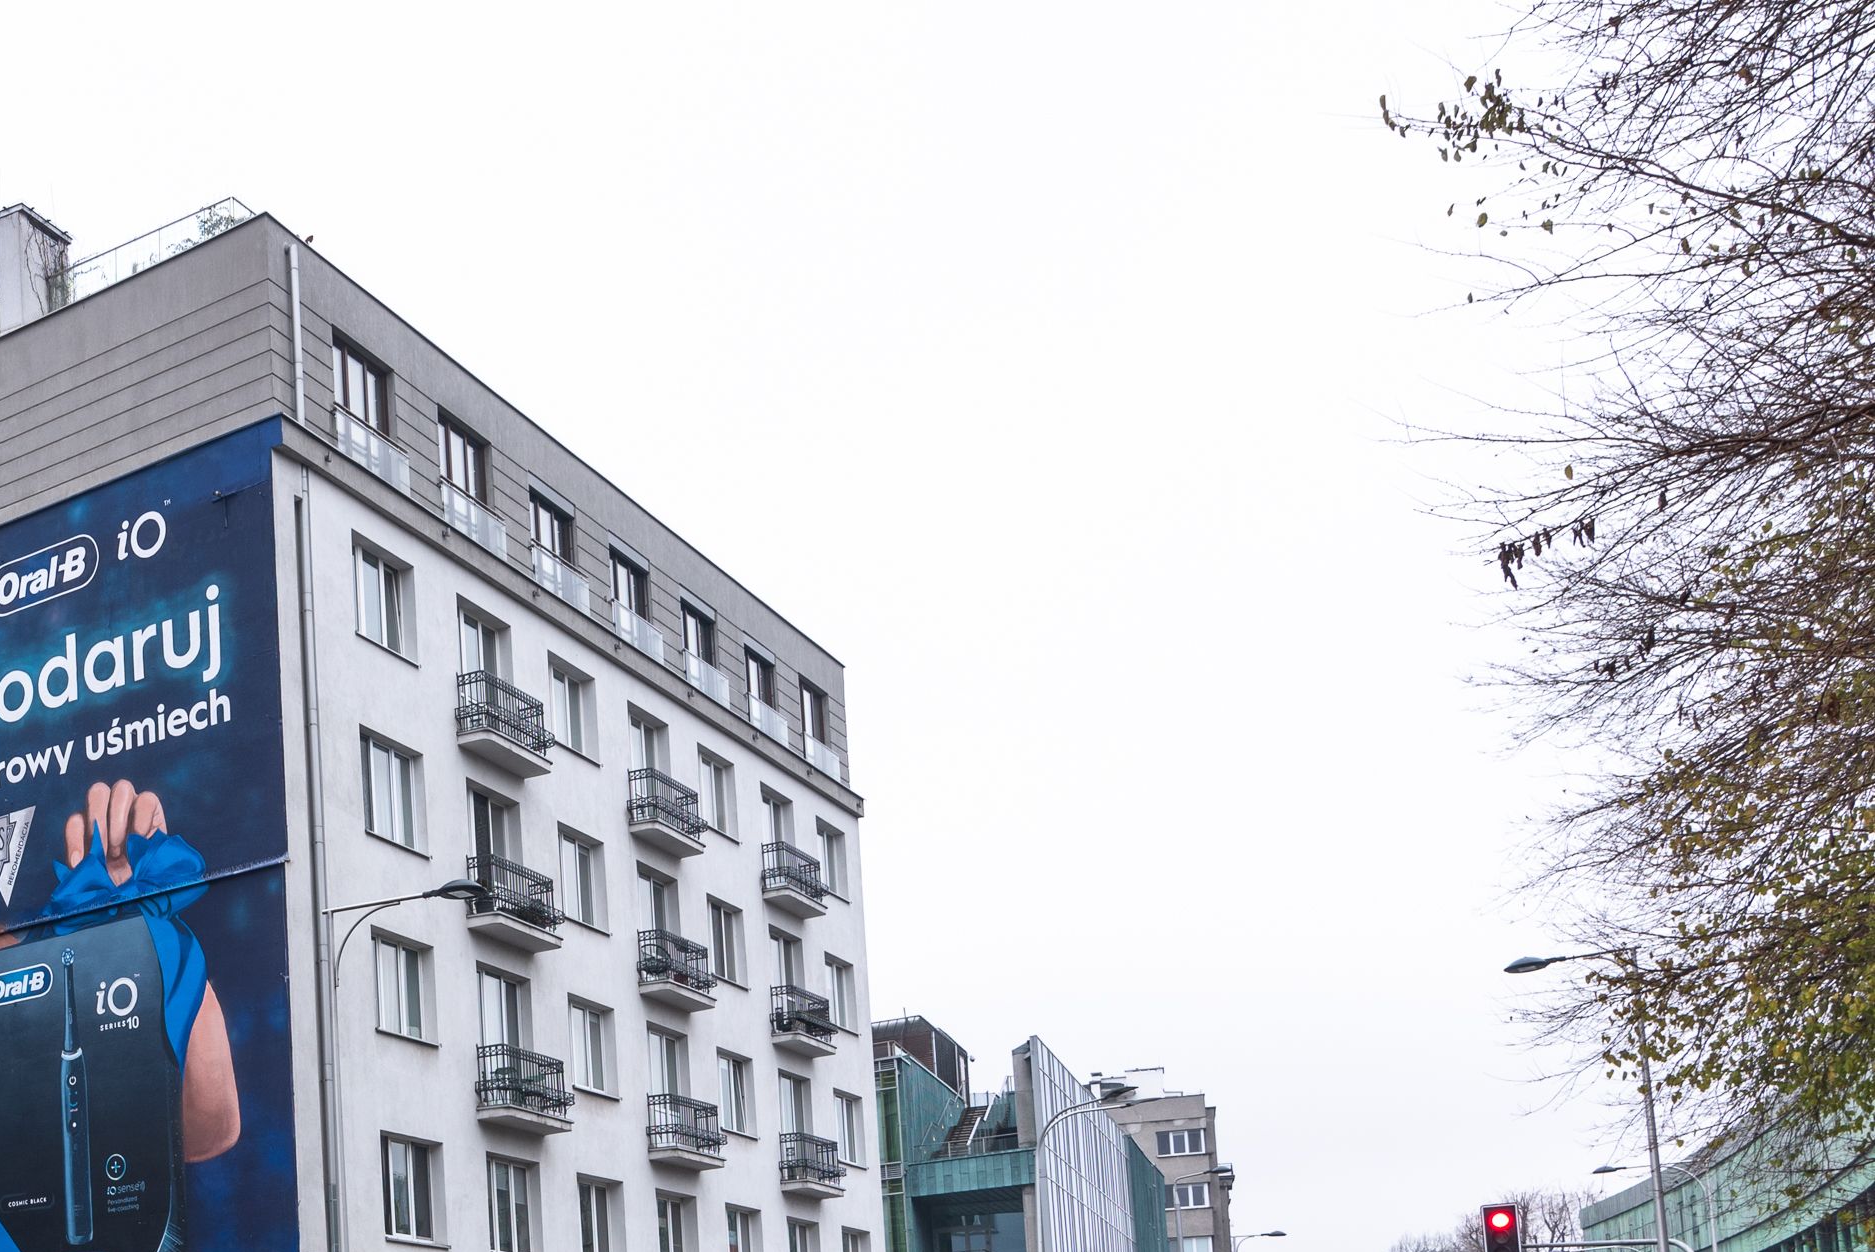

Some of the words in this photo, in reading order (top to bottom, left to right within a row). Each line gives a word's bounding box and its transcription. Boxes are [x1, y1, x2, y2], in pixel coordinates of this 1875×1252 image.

[85, 688, 231, 761] uśmiech
[100, 1022, 126, 1032] SERIES
[126, 1016, 140, 1030] 10
[8, 1199, 29, 1208] COSMIC
[30, 1197, 47, 1205] BLACK
